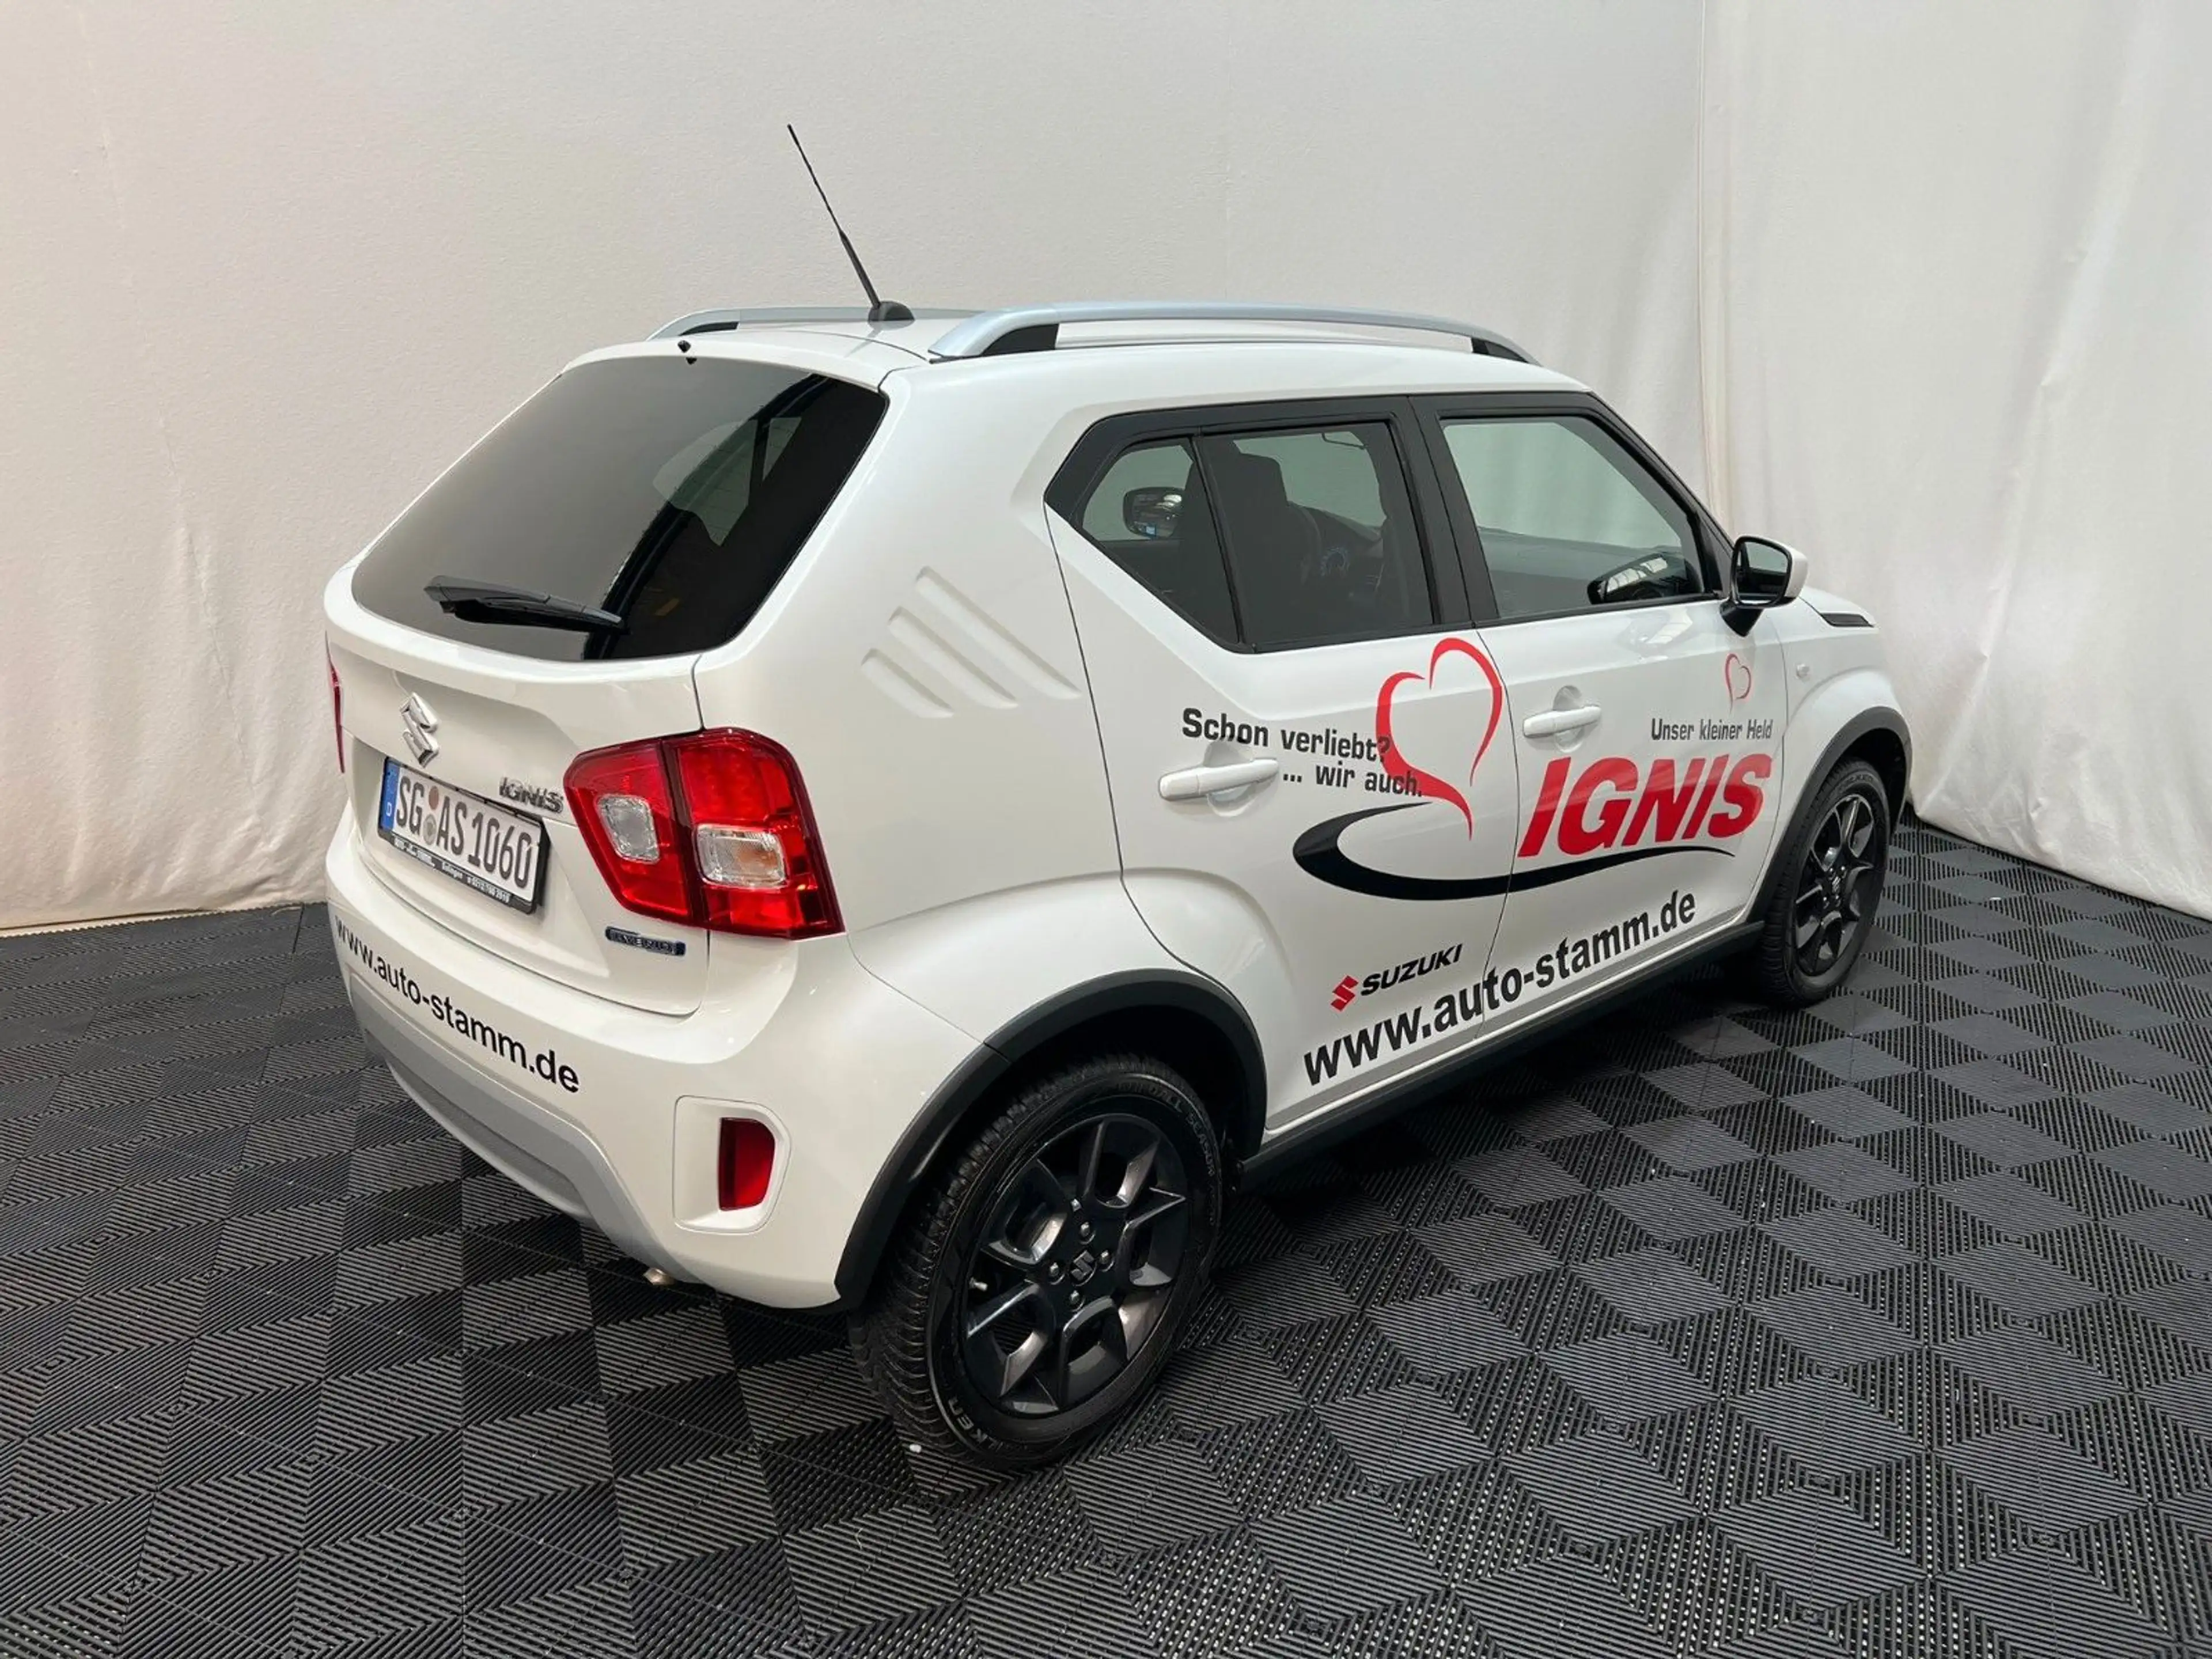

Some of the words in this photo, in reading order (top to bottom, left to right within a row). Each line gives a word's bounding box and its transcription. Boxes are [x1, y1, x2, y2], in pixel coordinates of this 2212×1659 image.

[1182, 707, 1268, 747] Schon
[1281, 728, 1391, 763] verliebt?
[1652, 718, 1694, 741] Unser
[1699, 719, 1743, 740] kleiner
[1746, 719, 1773, 740] Held
[396, 776, 425, 835] SG
[498, 777, 565, 814] IGNIS
[1316, 760, 1355, 788] wir
[1364, 770, 1422, 797] auch.
[1518, 754, 1772, 858] IGNIS
[1304, 890, 1696, 1086] www.auto-stamm.de
[1361, 944, 1463, 997] SUZUKI
[335, 915, 579, 1093] www.auto-stamm.de
